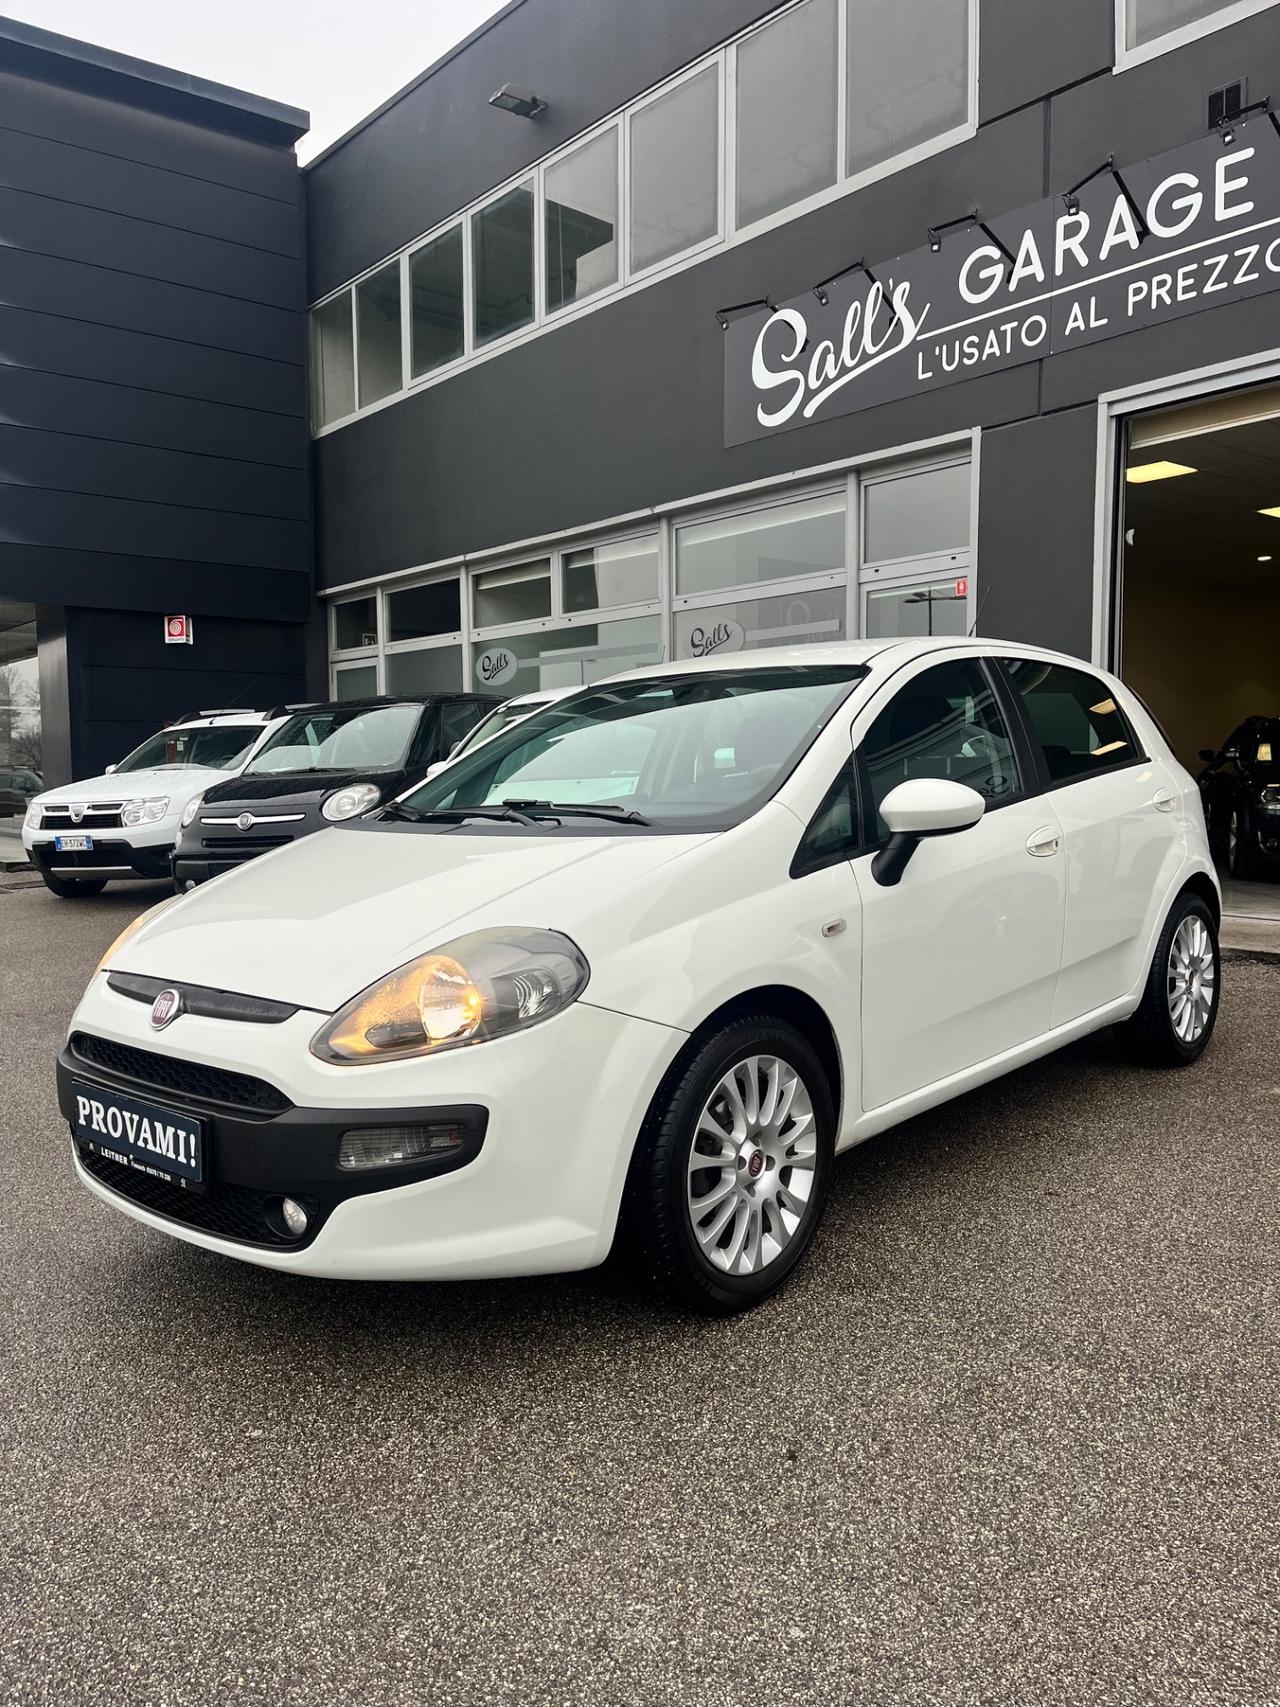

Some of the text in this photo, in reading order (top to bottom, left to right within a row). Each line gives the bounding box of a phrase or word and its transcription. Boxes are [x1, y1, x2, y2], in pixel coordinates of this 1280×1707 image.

[958, 147, 1255, 304] GARAGE
[917, 315, 1047, 380] L'USATO
[1065, 296, 1109, 336] AL
[77, 1095, 196, 1168] PROVAMI!
